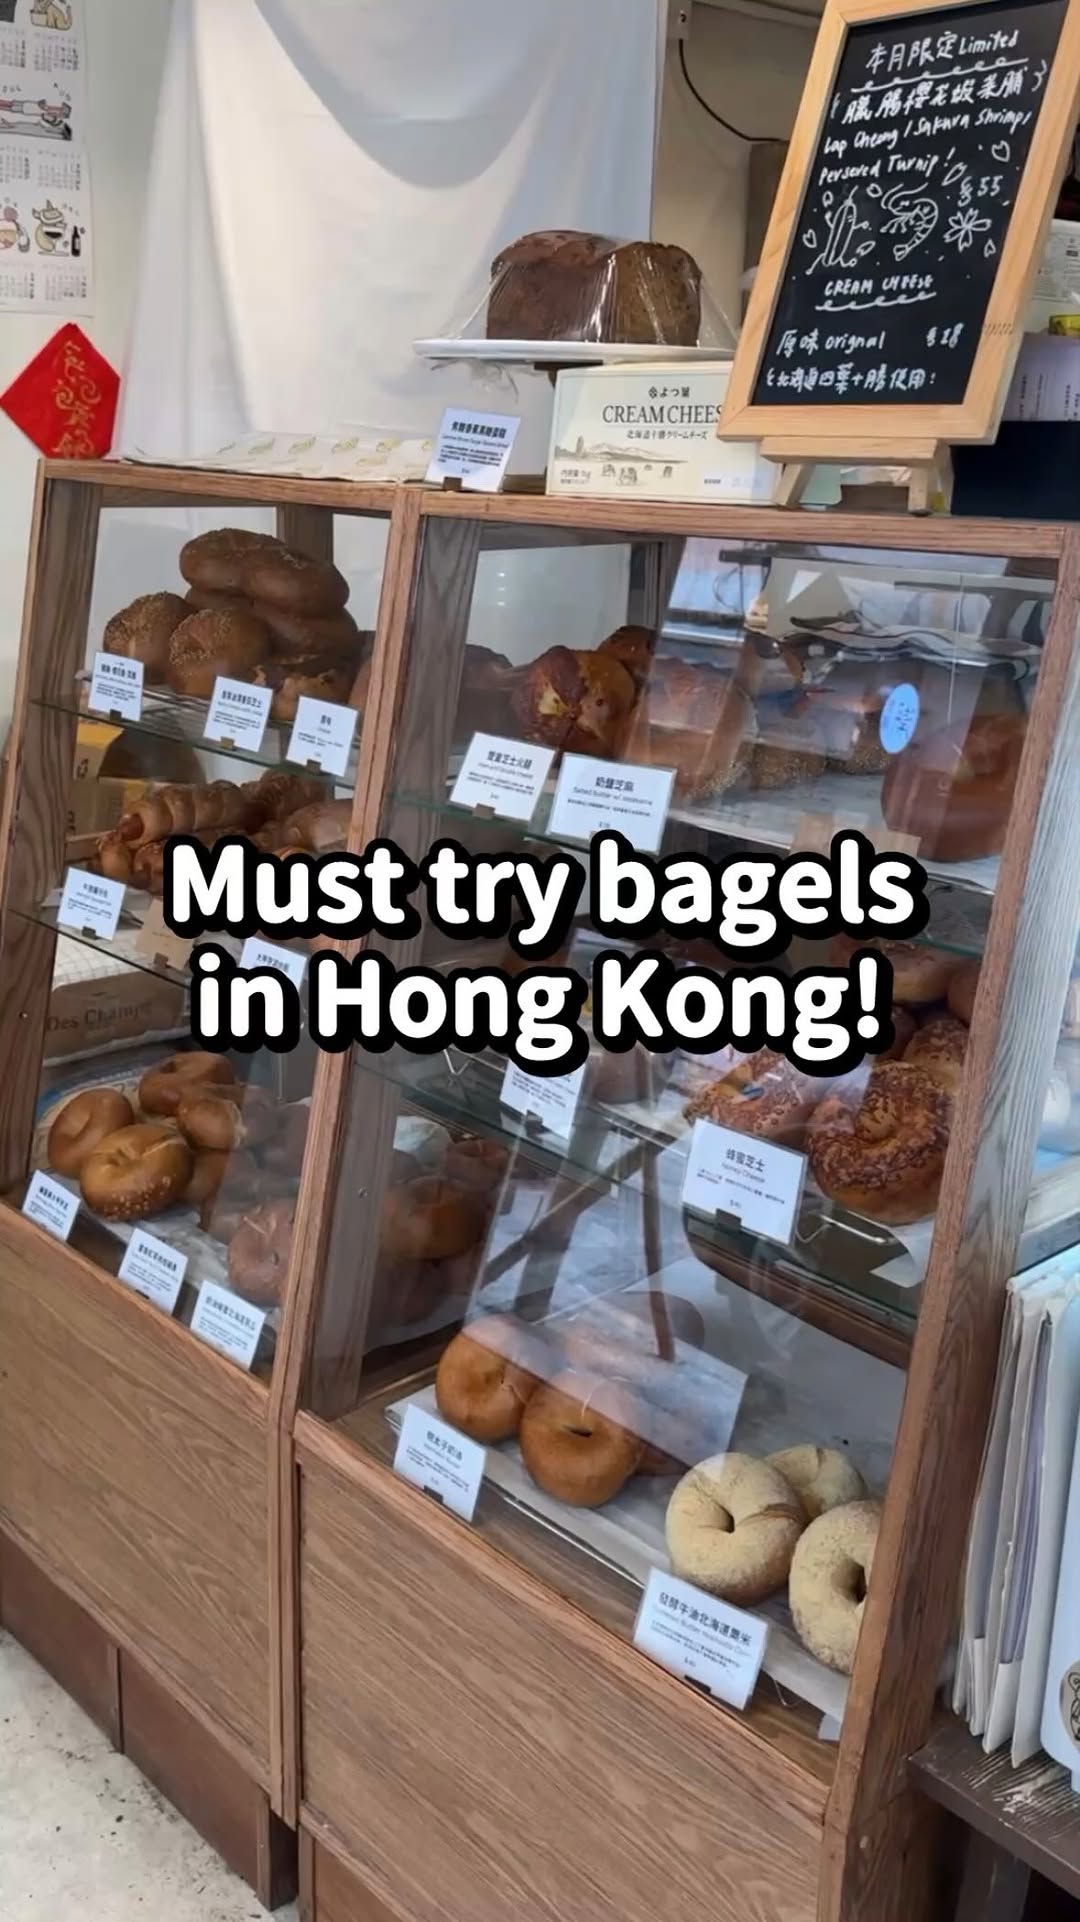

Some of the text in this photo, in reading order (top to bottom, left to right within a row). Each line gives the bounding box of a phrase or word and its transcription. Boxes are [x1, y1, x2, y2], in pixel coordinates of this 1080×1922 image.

[866, 29, 1019, 74] 本月限定 Limited
[824, 136, 848, 159] Lap
[854, 129, 898, 150] Cheong
[824, 273, 934, 296] CREAM CHEESE
[776, 328, 820, 358] 原味
[602, 404, 664, 423] CREAM
[726, 1148, 765, 1173] 蜂蜜芝士
